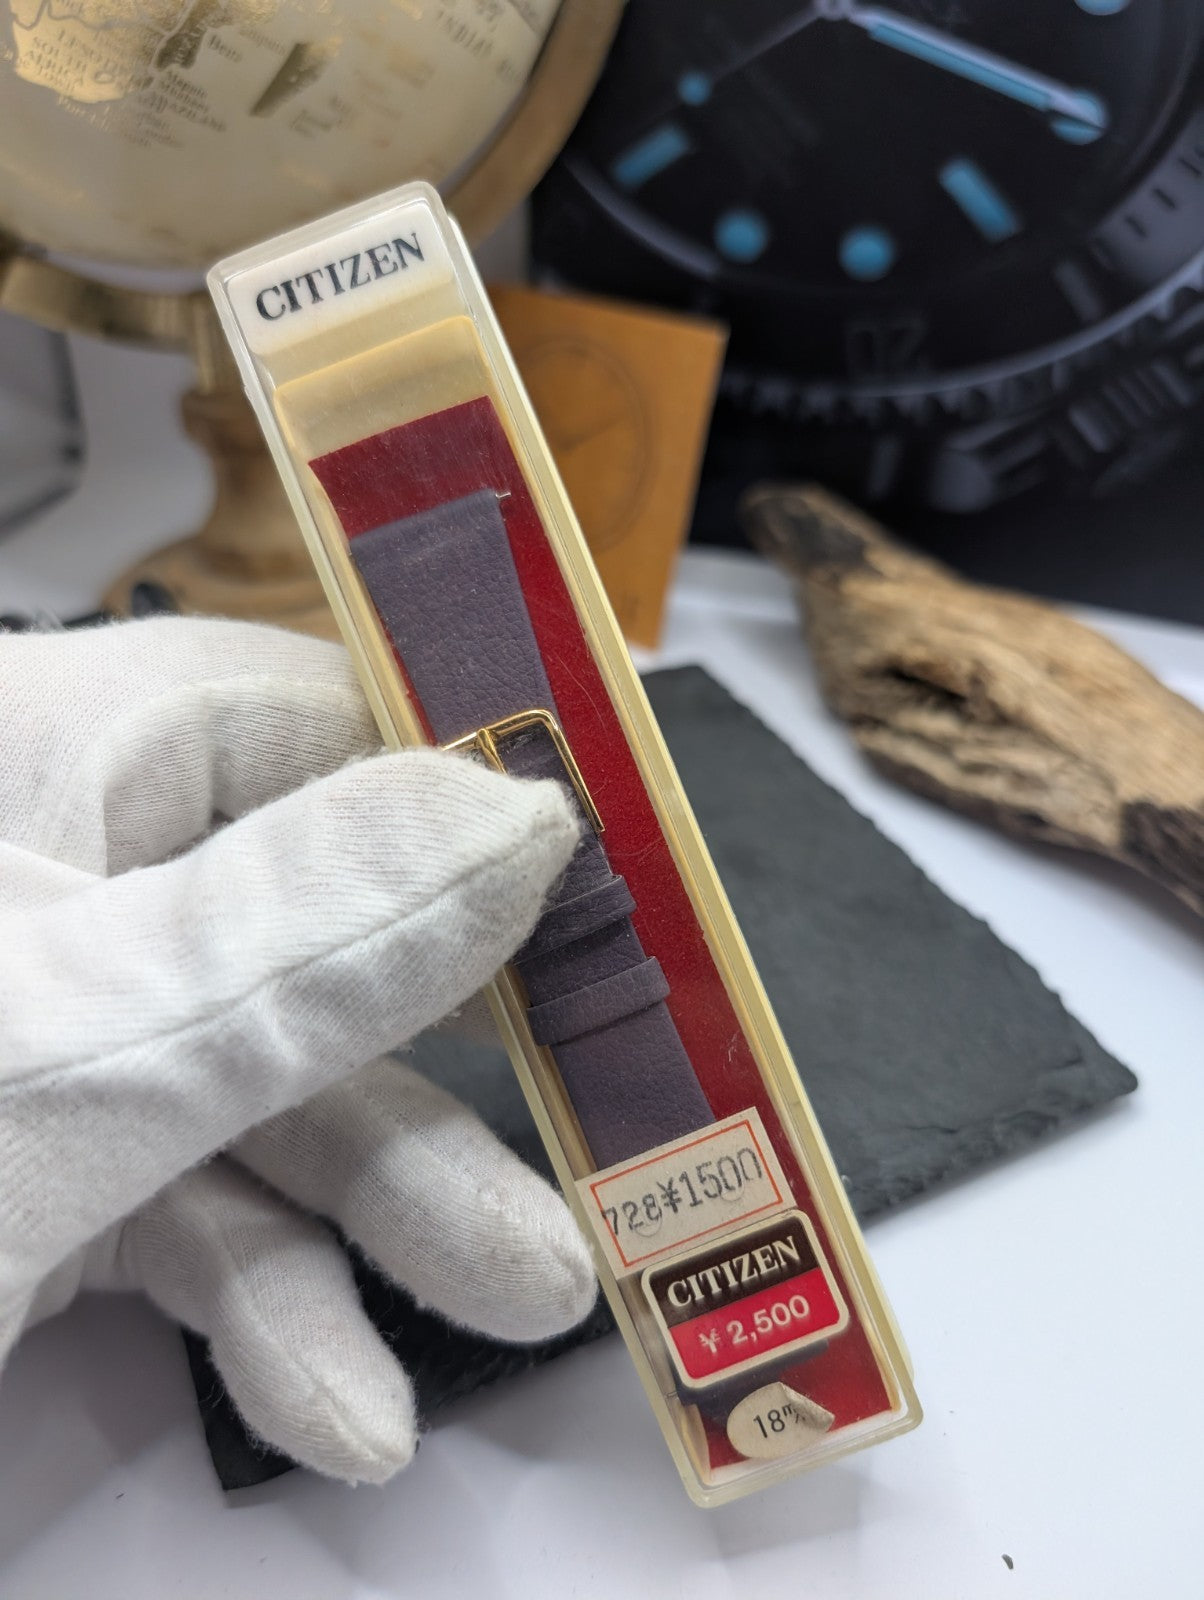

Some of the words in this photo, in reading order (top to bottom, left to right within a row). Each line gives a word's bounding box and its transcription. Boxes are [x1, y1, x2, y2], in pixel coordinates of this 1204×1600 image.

[255, 232, 425, 321] CITIZEN
[667, 1235, 801, 1308] CITIZEN
[726, 1294, 811, 1345] 2,500
